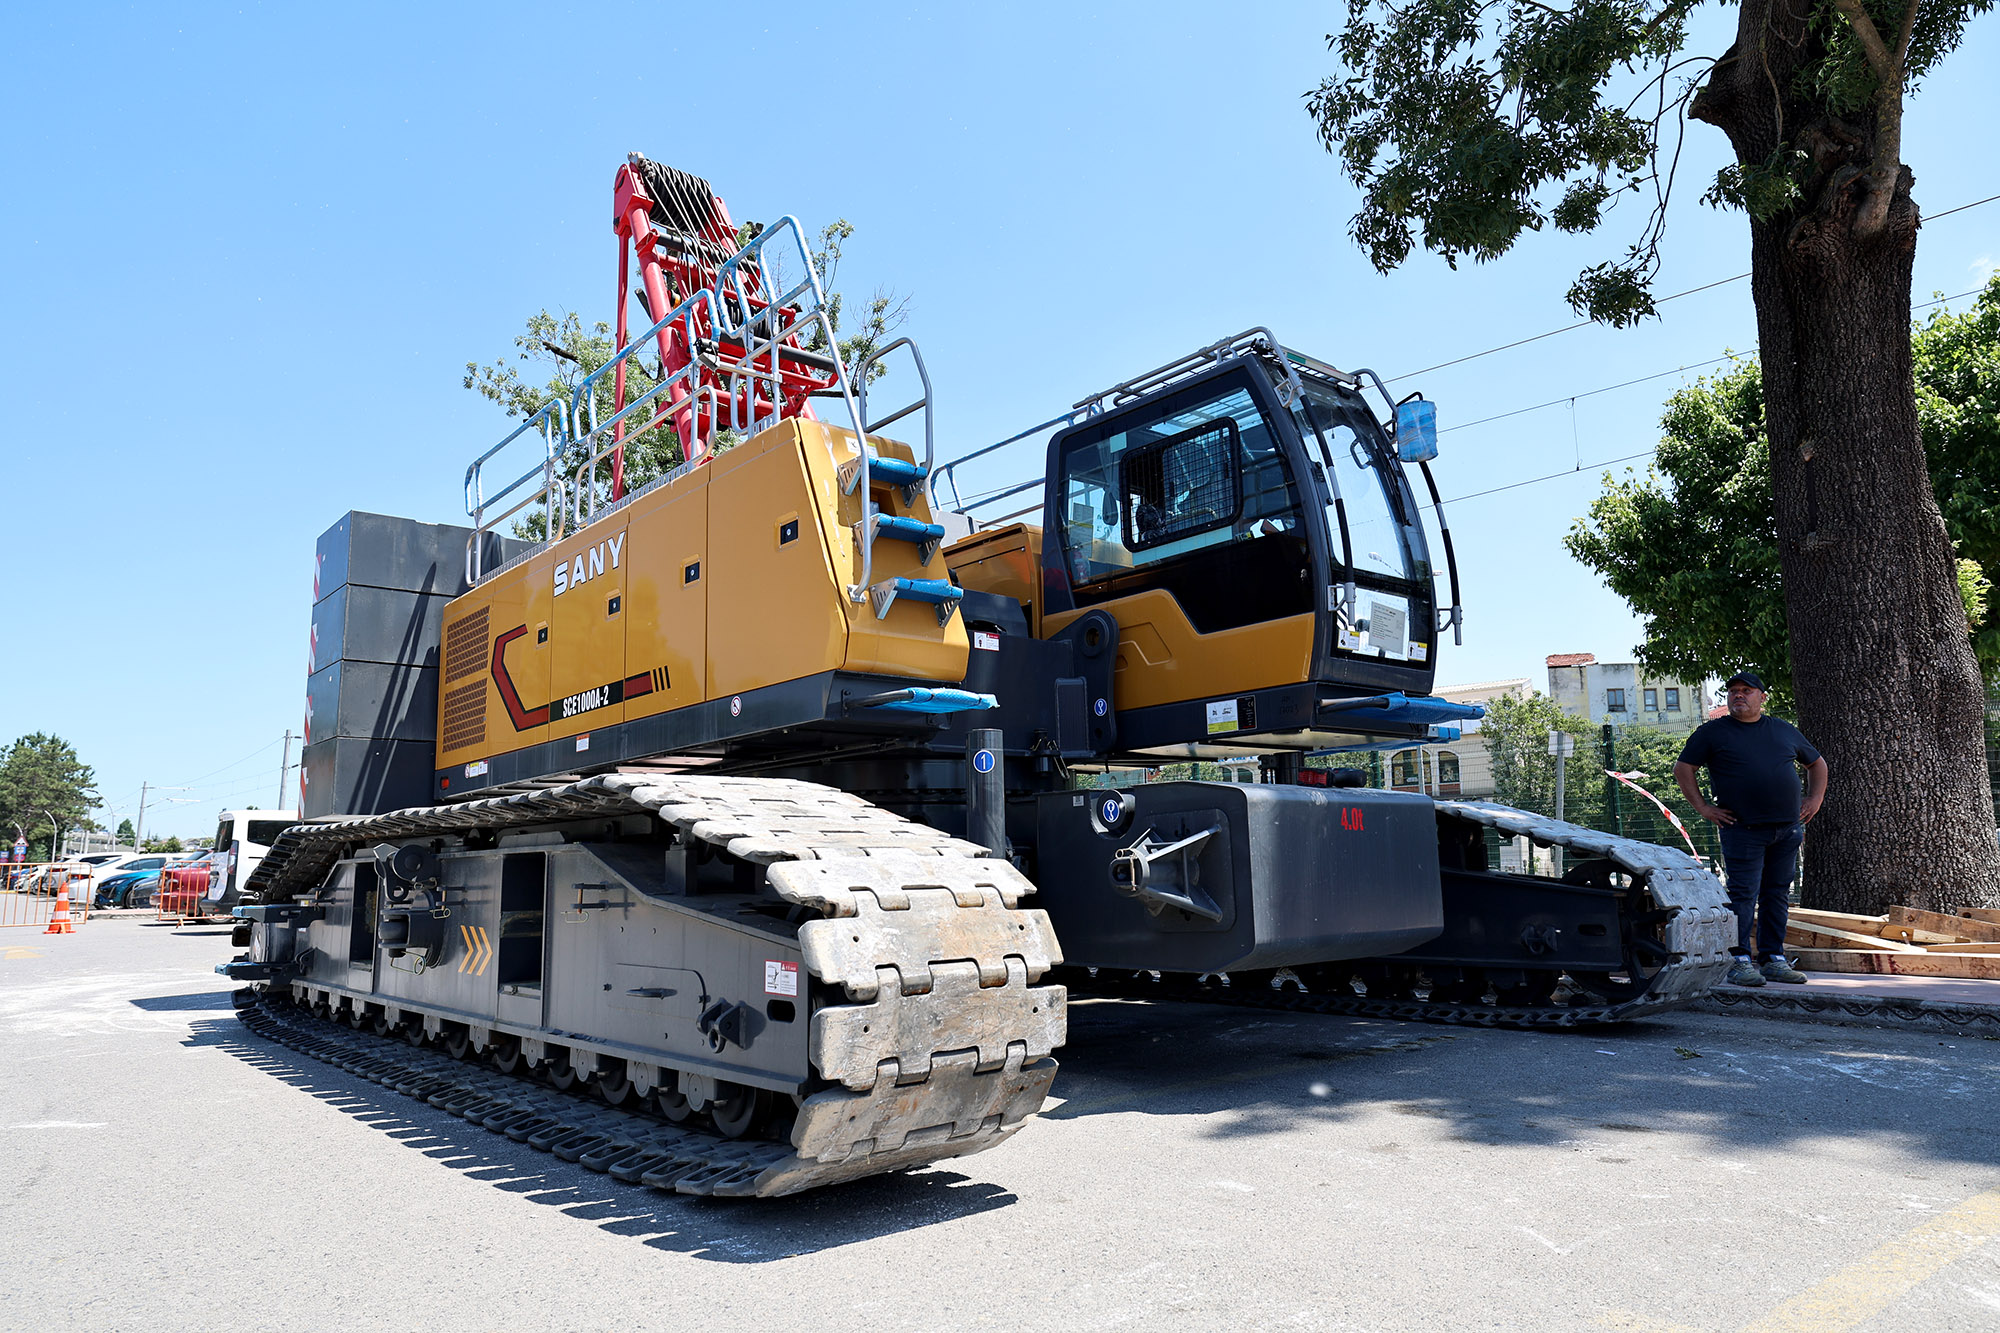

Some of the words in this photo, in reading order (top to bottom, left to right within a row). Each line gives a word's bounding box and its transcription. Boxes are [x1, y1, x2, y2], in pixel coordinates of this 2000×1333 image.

[553, 530, 626, 598] SANY
[563, 685, 609, 718] SCE1000A-2
[981, 753, 986, 770] 1
[1341, 807, 1364, 831] 4.0t
